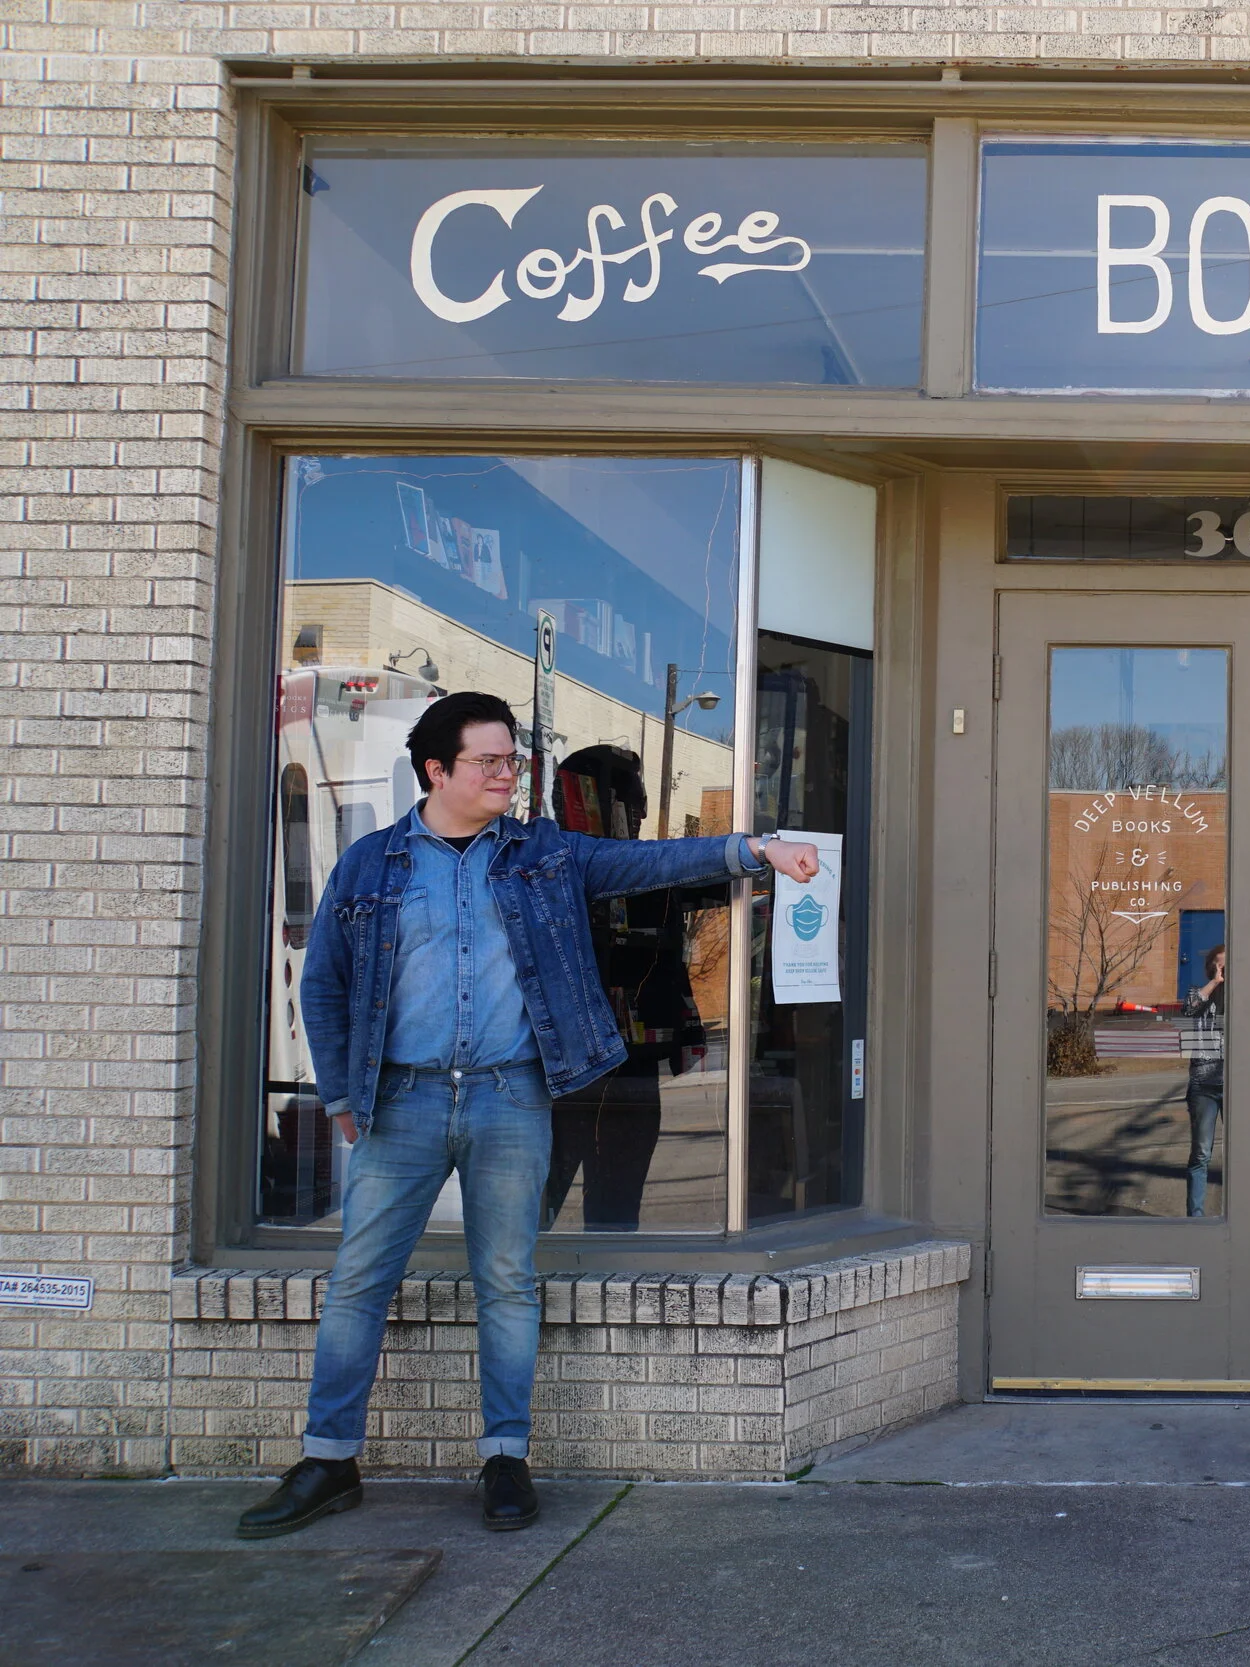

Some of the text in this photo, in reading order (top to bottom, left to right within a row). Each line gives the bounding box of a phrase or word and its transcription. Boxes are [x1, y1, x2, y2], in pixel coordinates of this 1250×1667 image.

[410, 183, 813, 325] Coffee
[1074, 784, 1209, 834] DEEP VELLUM
[1112, 820, 1171, 834] BOOKS
[1131, 849, 1149, 867] &
[1091, 881, 1182, 892] PUBLISHING
[1130, 897, 1150, 907] CO.
[21, 1282, 86, 1296] 264535-2015
